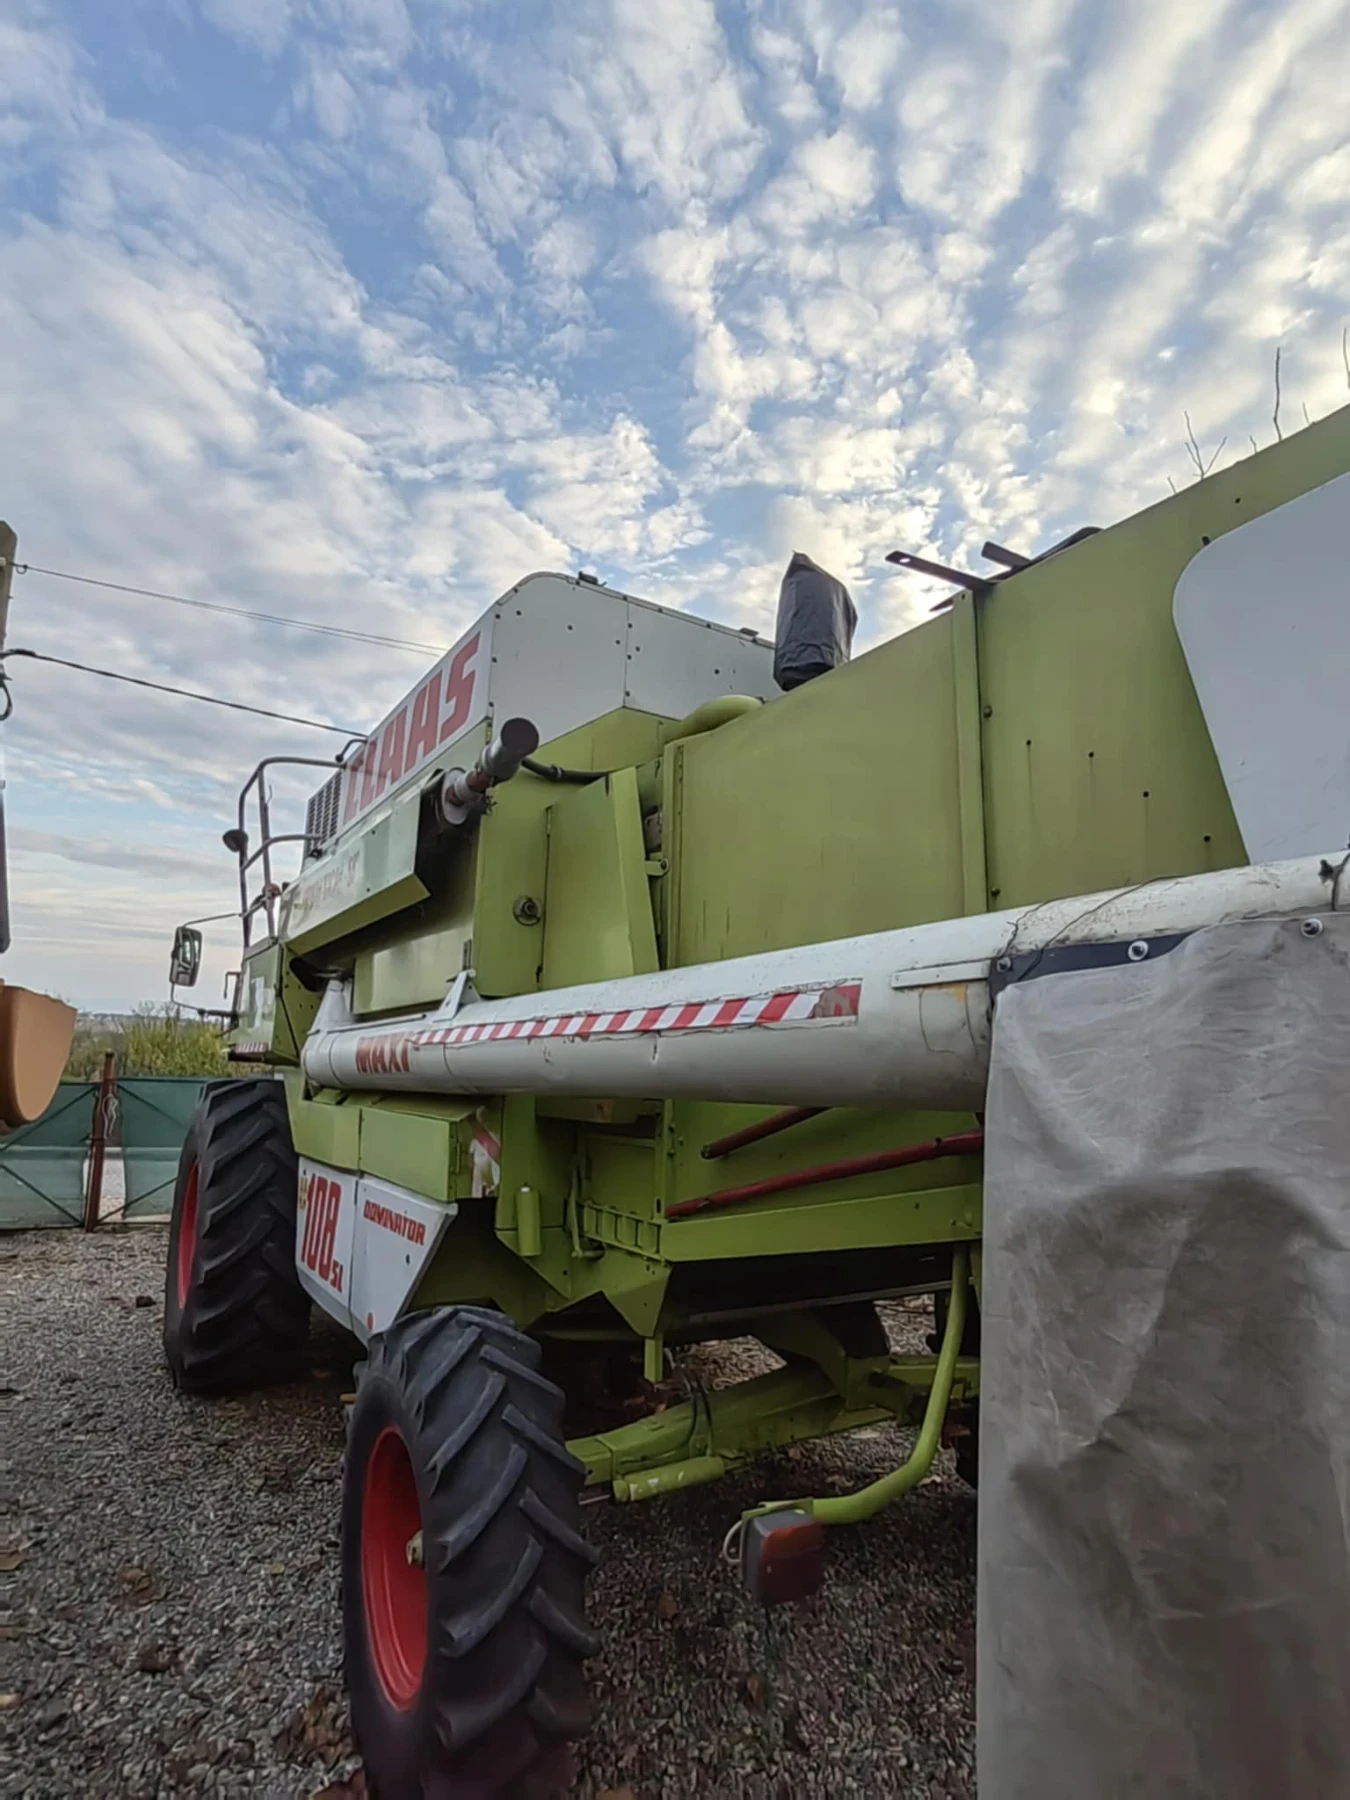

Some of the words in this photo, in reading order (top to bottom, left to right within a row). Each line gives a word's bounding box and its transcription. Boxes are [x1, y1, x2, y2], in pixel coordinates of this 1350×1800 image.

[343, 630, 481, 825] CLAAS
[355, 1030, 410, 1073] MAXI
[363, 1199, 427, 1246] DOMINATOR
